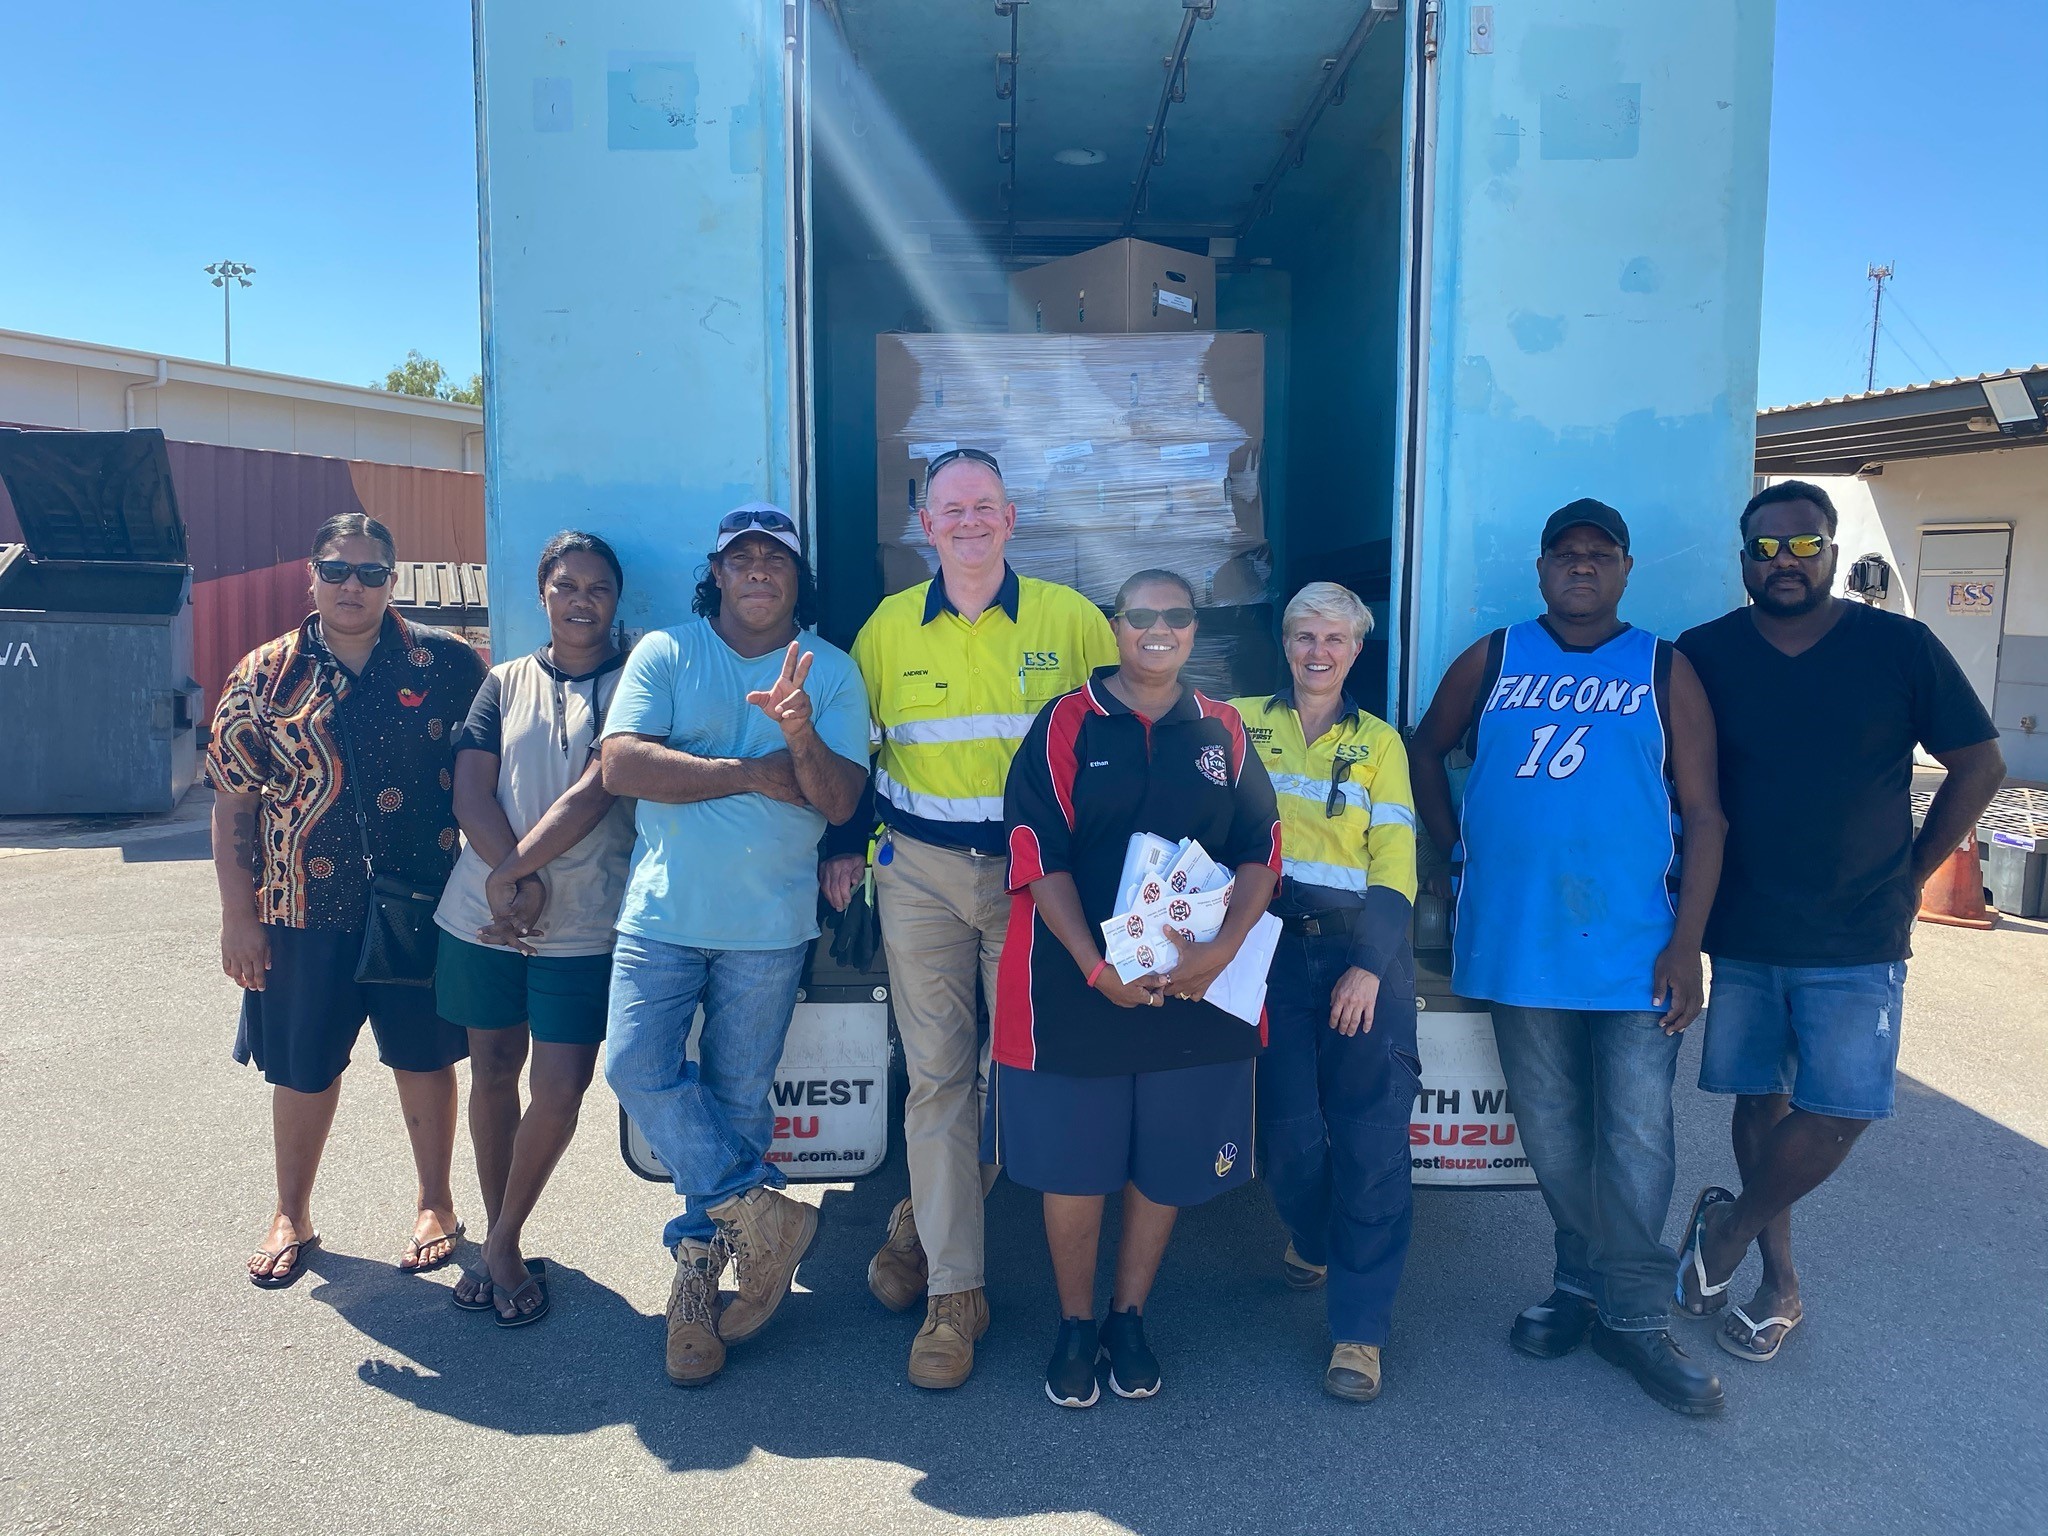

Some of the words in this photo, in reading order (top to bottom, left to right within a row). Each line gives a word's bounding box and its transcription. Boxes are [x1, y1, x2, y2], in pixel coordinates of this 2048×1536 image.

[1948, 584, 1994, 607] ESS
[1023, 652, 1060, 667] ESS
[902, 669, 929, 678] ANDREW
[1486, 674, 1651, 716] FALCONS
[1336, 743, 1370, 757] ESS
[1515, 724, 1593, 780] 16
[1090, 760, 1109, 768] Ethan
[773, 1080, 874, 1107] WEST
[1420, 1088, 1460, 1115] TH
[1408, 1123, 1516, 1146] SUZU
[762, 1150, 866, 1164] uzu.com.au
[1411, 1156, 1531, 1170] estisuzu.com
